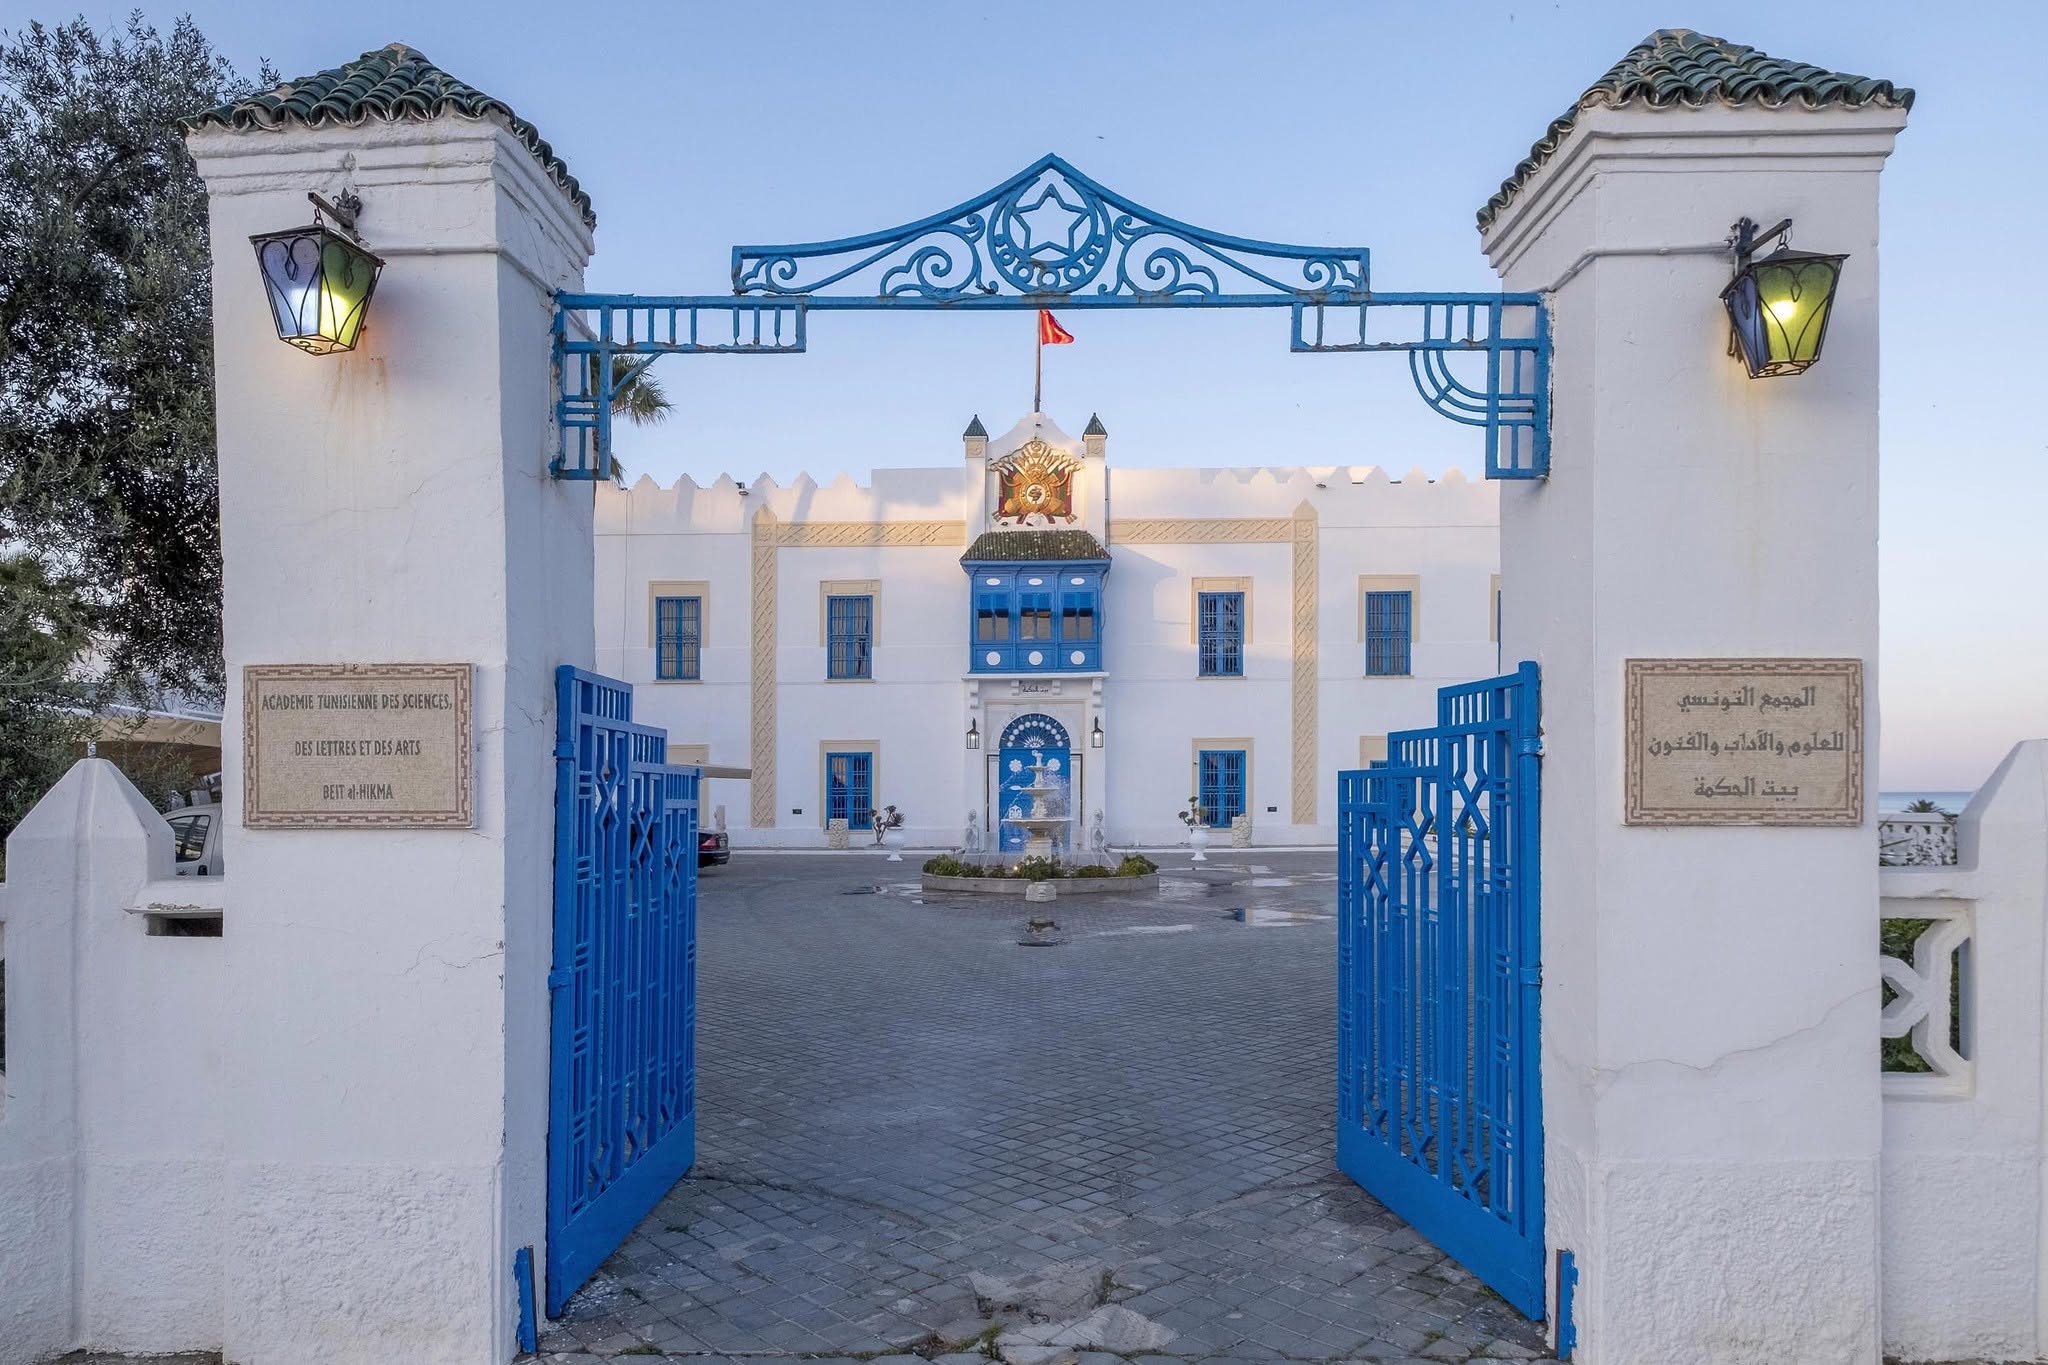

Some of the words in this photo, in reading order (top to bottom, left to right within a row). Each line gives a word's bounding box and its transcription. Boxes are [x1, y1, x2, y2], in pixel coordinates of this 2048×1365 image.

[262, 694, 314, 711] ACADEMIE
[317, 694, 378, 710] TUNISIENNE
[382, 694, 400, 710] DES
[402, 693, 453, 710] SCIENCES,
[1677, 685, 1754, 713] التونسي
[1759, 685, 1816, 715] المجمع
[295, 741, 313, 756] DES
[316, 741, 357, 756] LETTRES
[359, 741, 371, 756] ET
[374, 741, 393, 756] DES
[394, 740, 421, 755] ARTS
[1648, 730, 1719, 757] والفنون
[1724, 729, 1786, 756] والآداب
[1787, 730, 1844, 758] للعلوم
[323, 784, 344, 800] BEIT
[1694, 776, 1756, 798] الحكمة
[1761, 780, 1799, 802] بيت
